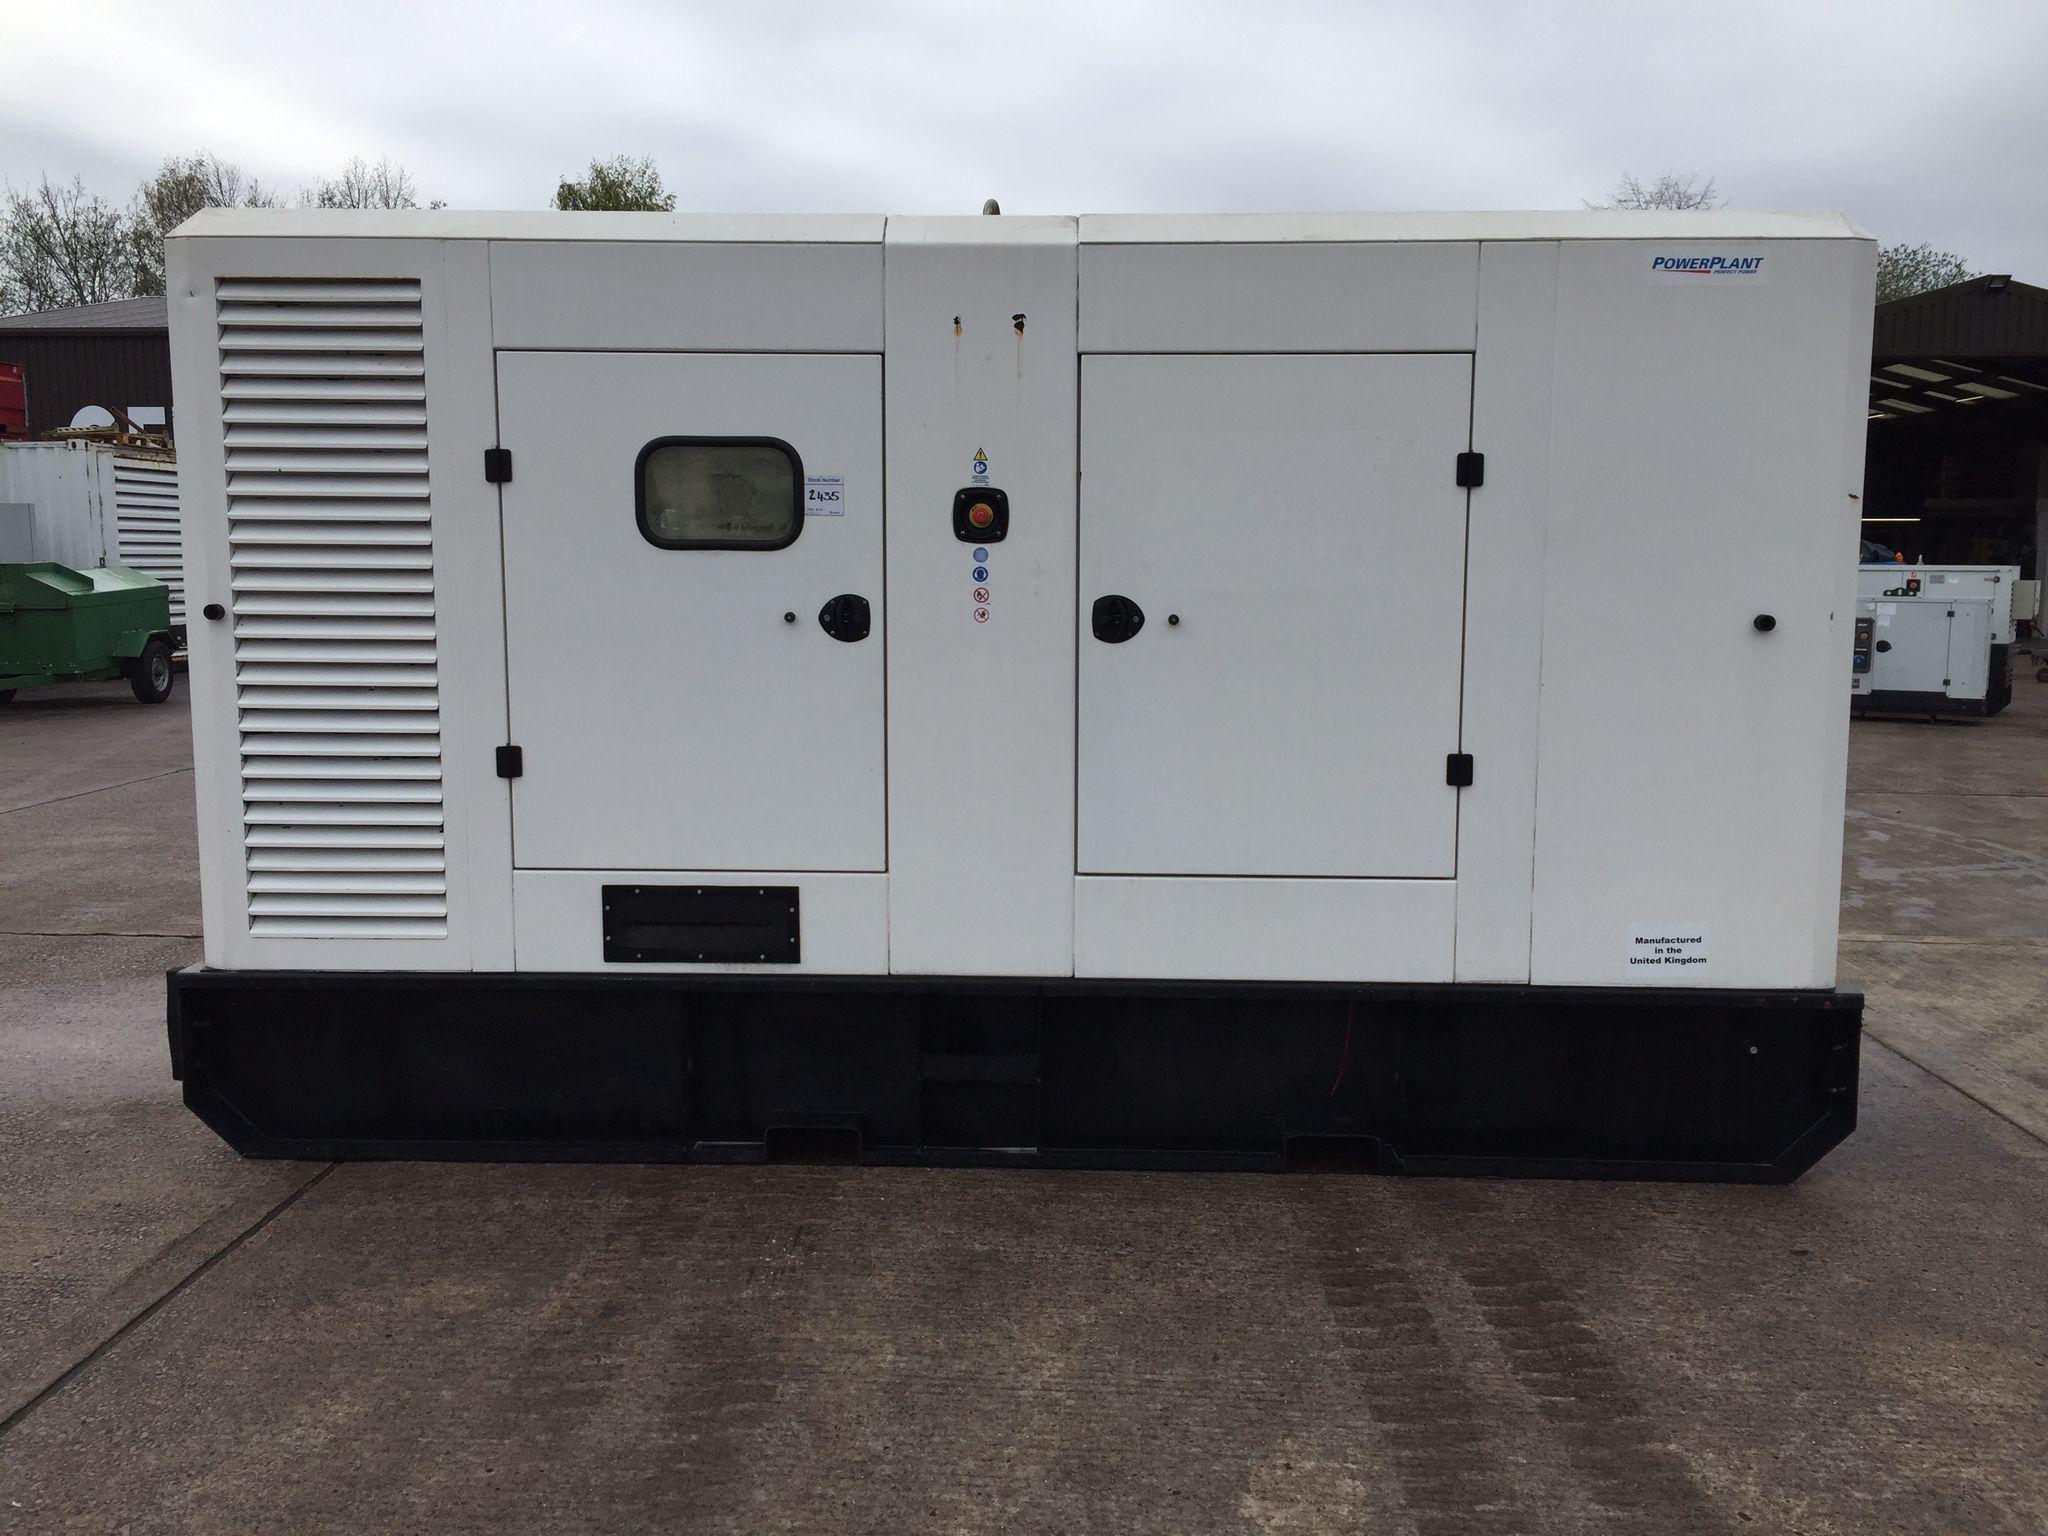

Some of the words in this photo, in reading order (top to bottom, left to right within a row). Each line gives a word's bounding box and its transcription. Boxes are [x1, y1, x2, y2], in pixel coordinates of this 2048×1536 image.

[1652, 256, 1765, 269] POWERPLANT
[809, 489, 840, 502] 2435
[1635, 936, 1702, 944] Manufactured
[1630, 957, 1662, 965] United
[1664, 956, 1707, 966] Kingdom
